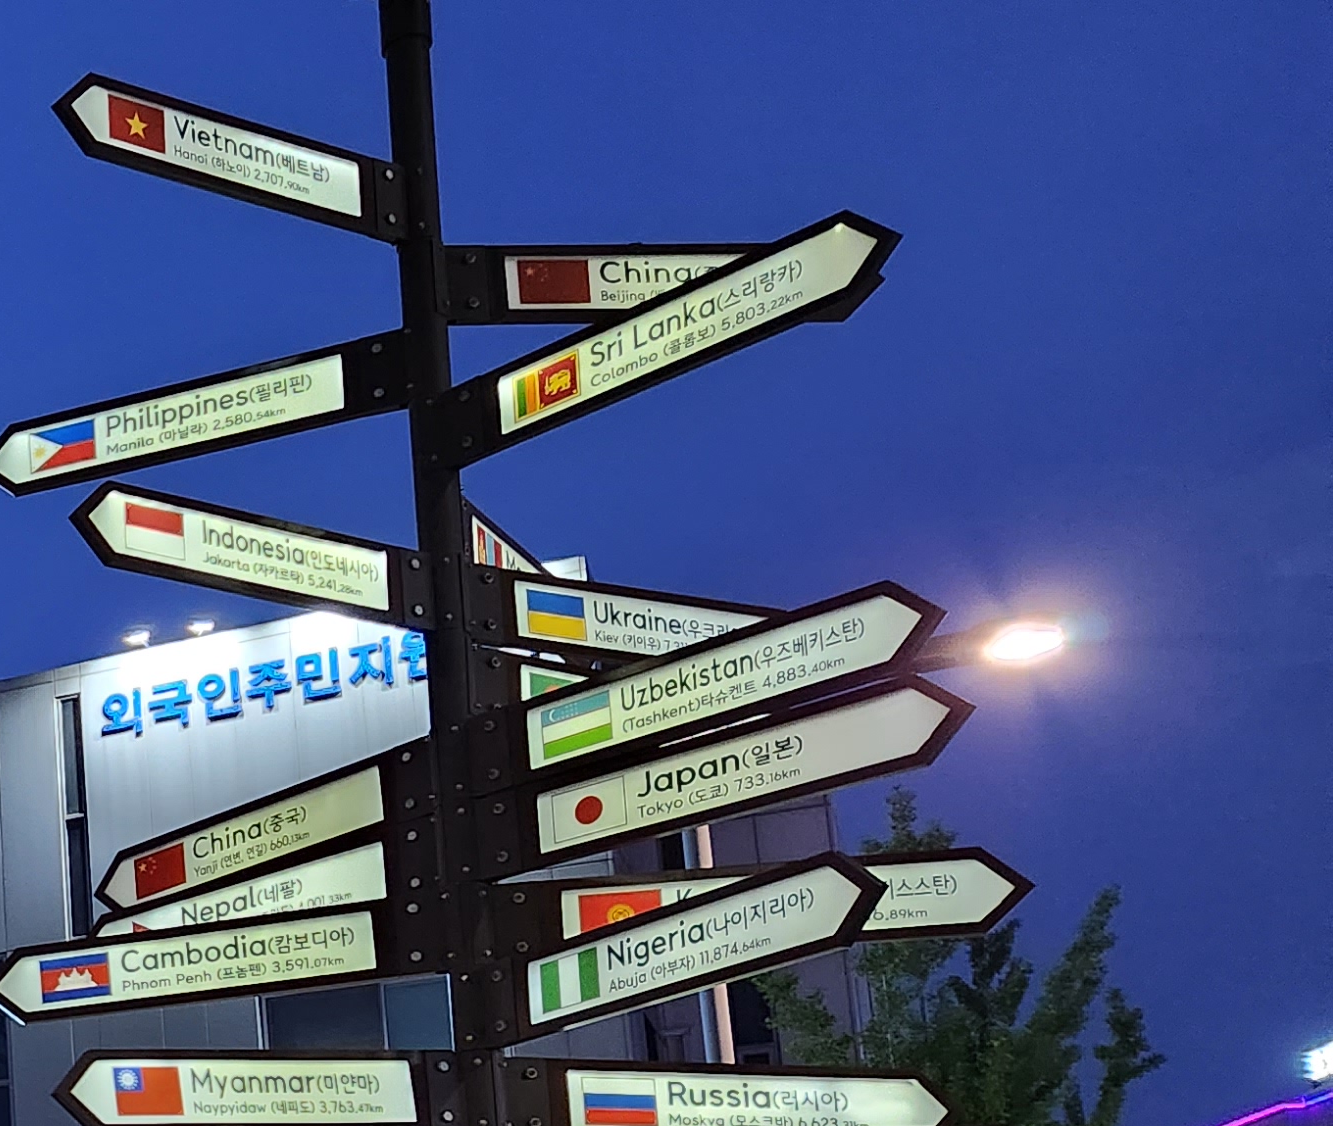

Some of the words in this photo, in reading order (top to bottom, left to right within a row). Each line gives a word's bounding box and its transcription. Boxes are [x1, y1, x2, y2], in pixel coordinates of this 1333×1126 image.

[173, 145, 208, 165] Hanoi
[211, 156, 251, 178] (하노이)
[599, 260, 718, 284] China(
[600, 290, 646, 304] Beijing
[590, 330, 623, 367] Sri
[590, 350, 658, 387] Colombo
[663, 324, 716, 357] (콜롬보)
[106, 434, 155, 456] Manila
[158, 422, 208, 444] (마닐라)
[202, 551, 250, 572] Jakarta
[594, 629, 620, 644] Kiev
[636, 735, 804, 799] Japan(일본)
[637, 795, 684, 820] Tokyo
[688, 780, 730, 808] (도쿄)
[733, 766, 802, 793] 733.16km
[193, 859, 219, 878] Yanji
[121, 978, 172, 992] Phnom
[176, 970, 212, 985] Penh
[608, 971, 647, 993] Abuja
[193, 1101, 267, 1116] Naypyidaw
[669, 1114, 725, 1126] Moskva
